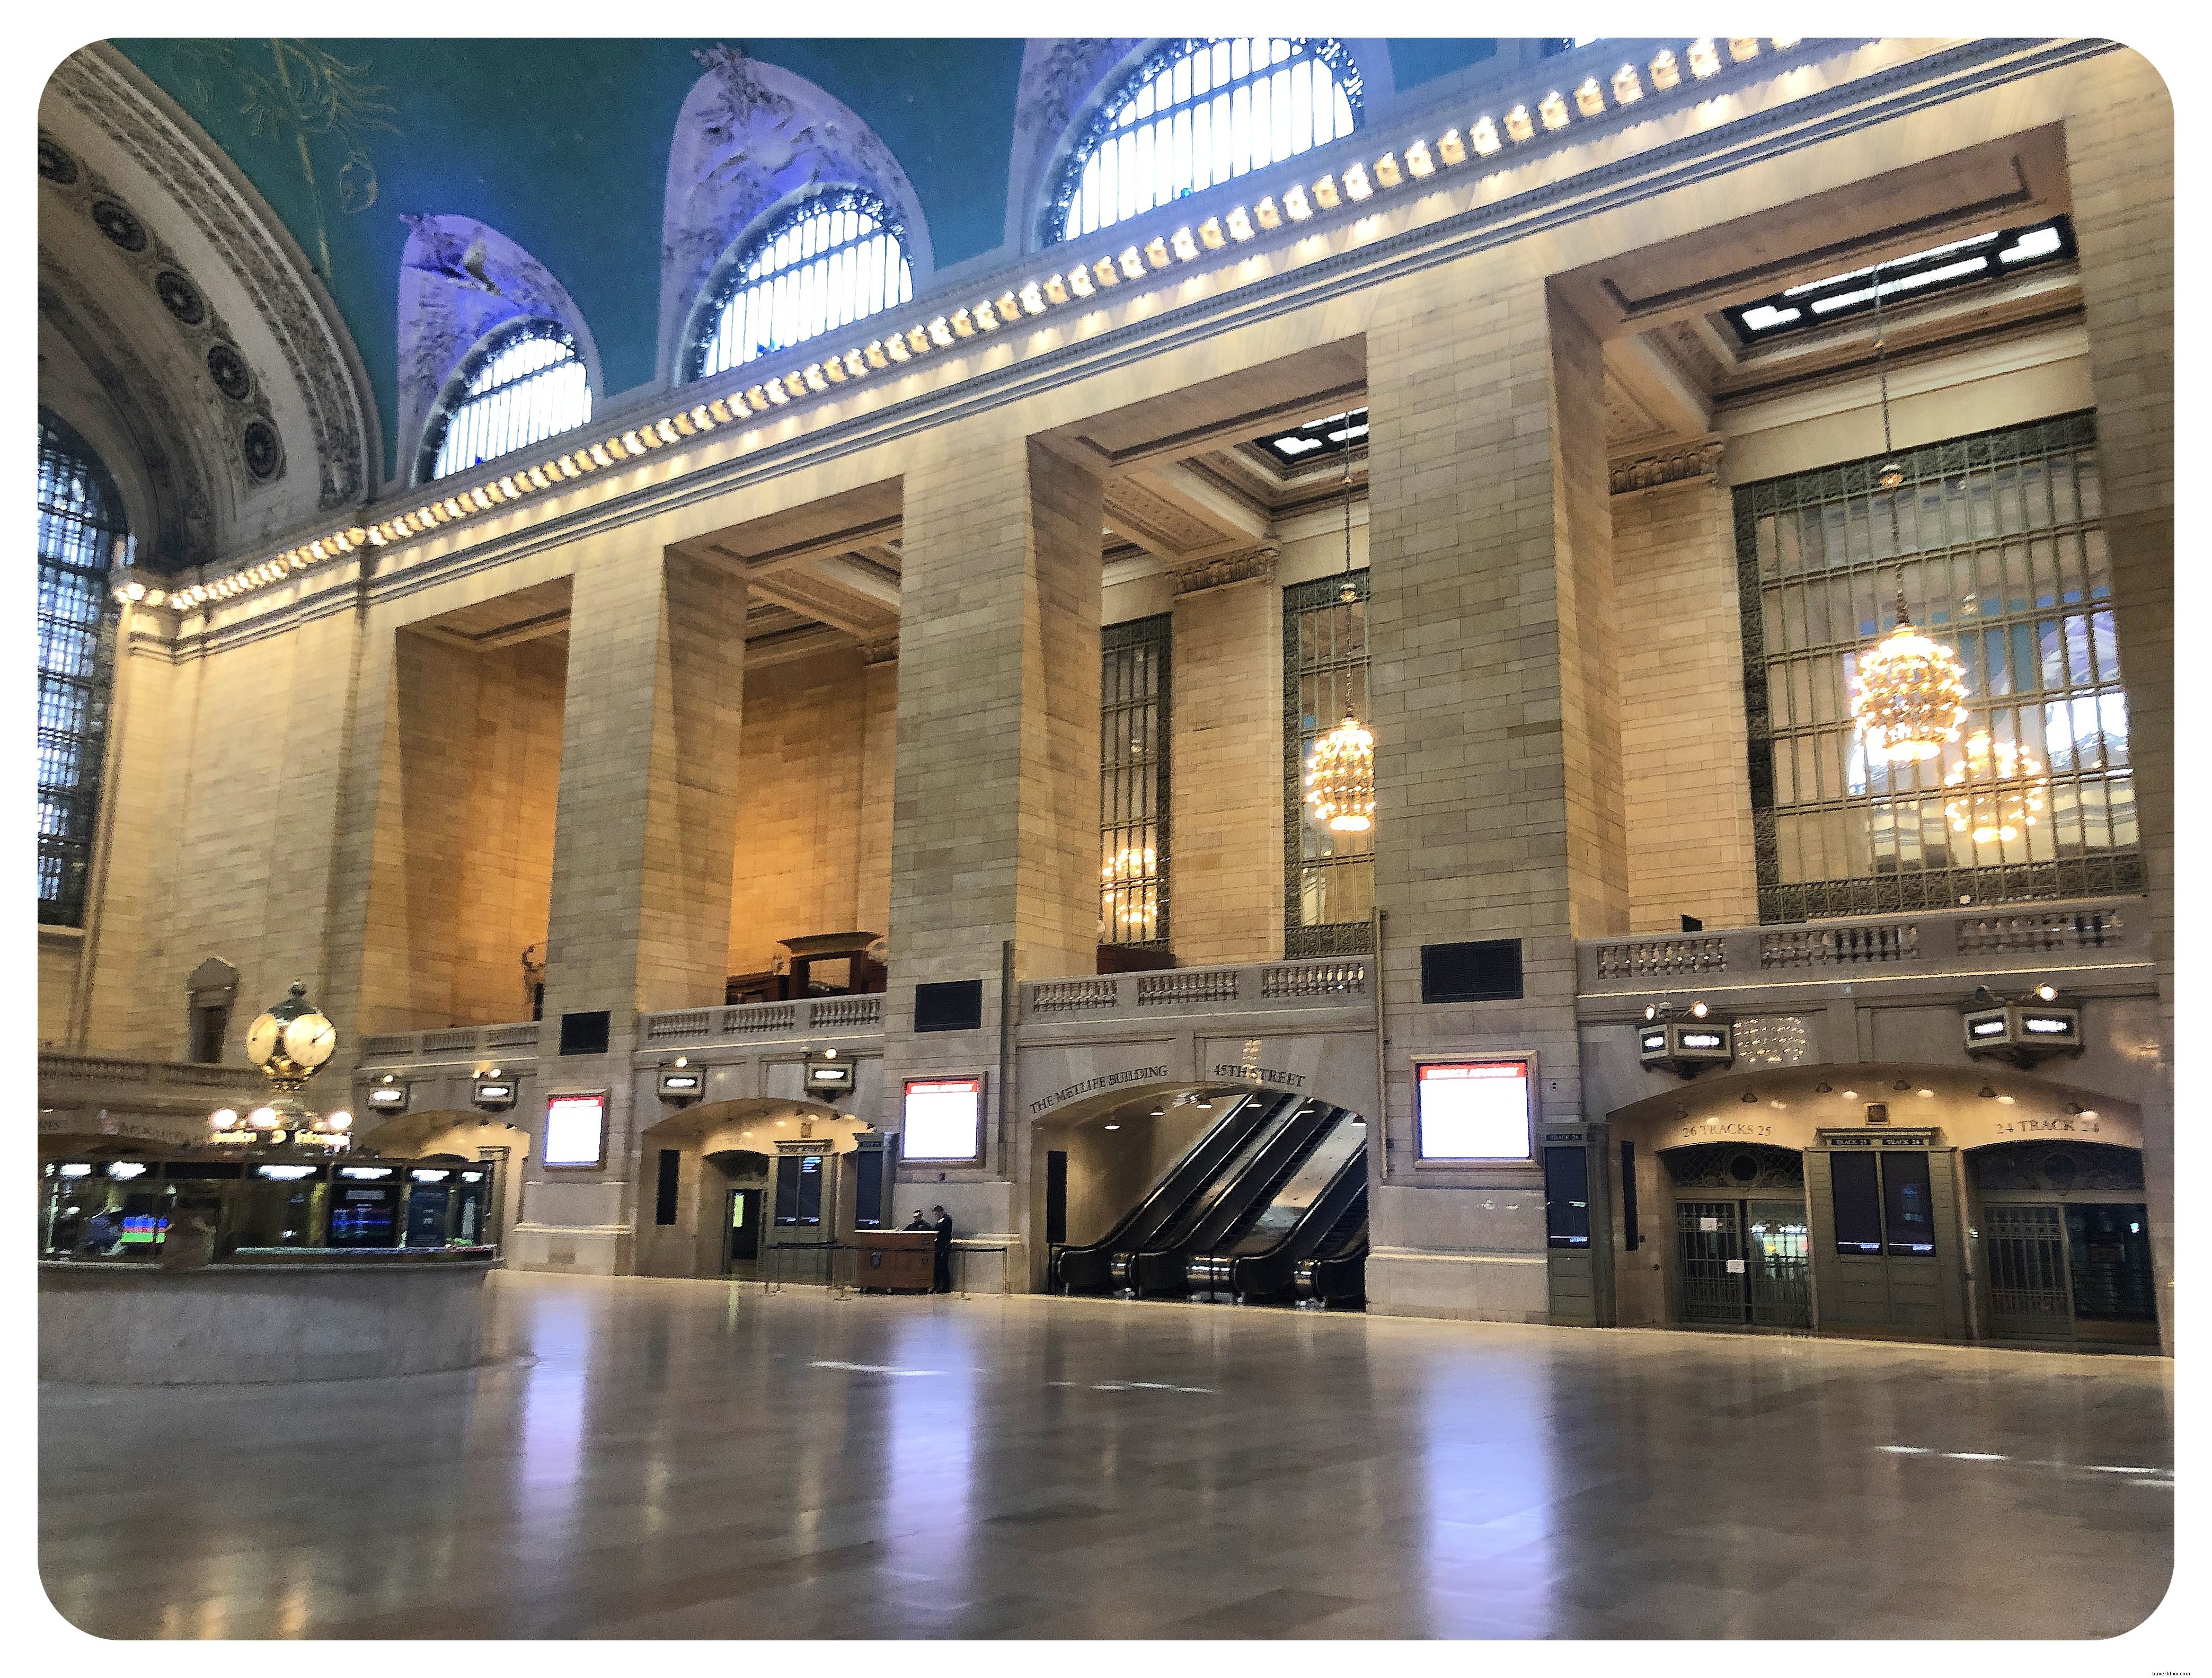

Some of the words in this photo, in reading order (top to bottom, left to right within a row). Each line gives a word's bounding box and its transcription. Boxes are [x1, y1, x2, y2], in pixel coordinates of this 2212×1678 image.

[1251, 1067, 1306, 1088] STREET
[1029, 1095, 1054, 1114] THE
[1054, 1076, 1107, 1103] METLIFE
[1108, 1064, 1169, 1086] BUILDING
[1683, 1126, 1696, 1138] 26
[1700, 1124, 1754, 1135] TRACKS
[1758, 1126, 1772, 1136] 25
[2017, 1119, 2075, 1132] TRACK
